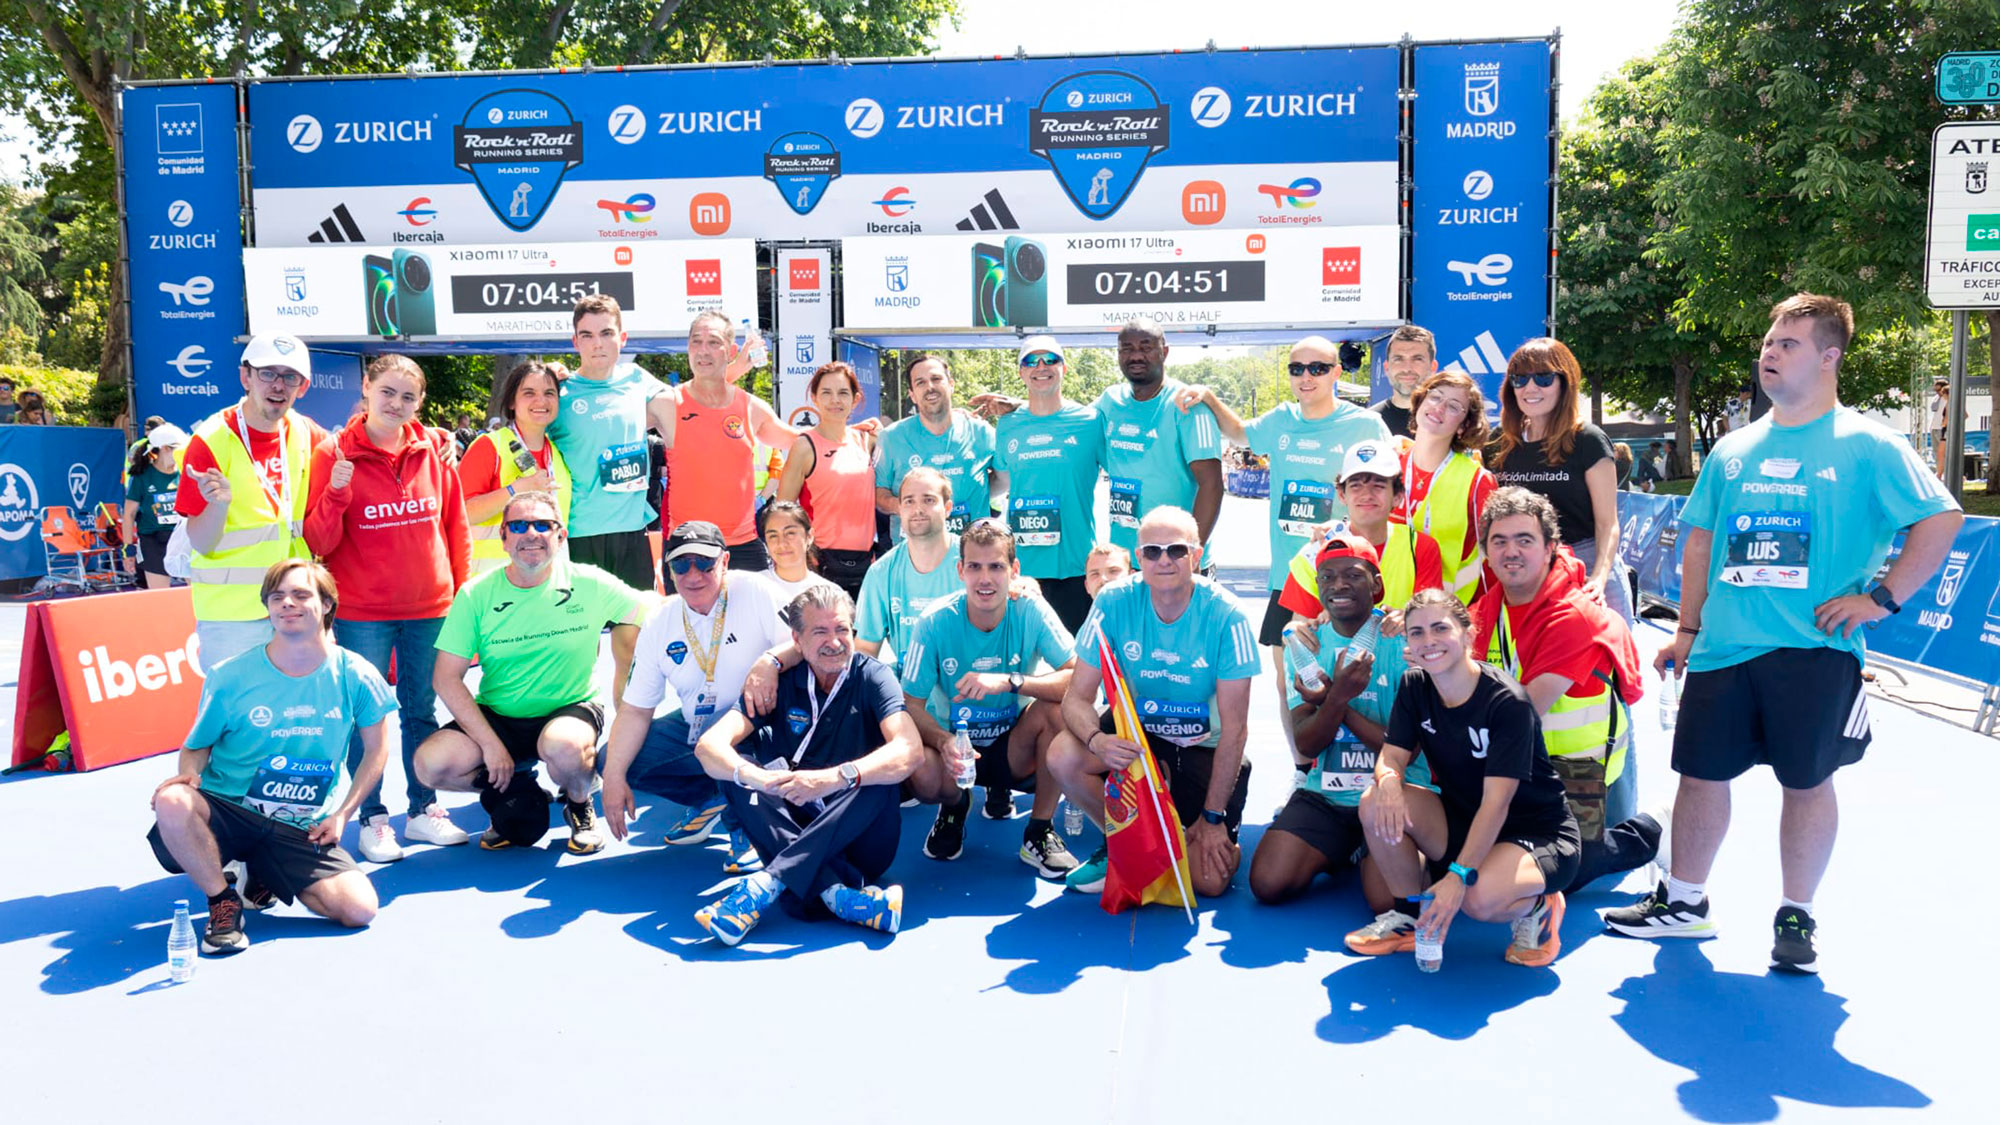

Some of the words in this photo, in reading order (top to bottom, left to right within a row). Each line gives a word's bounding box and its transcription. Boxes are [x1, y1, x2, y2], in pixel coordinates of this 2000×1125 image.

[1088, 92, 1131, 103] ZURICH
[1244, 93, 1356, 118] ZURICH
[507, 110, 548, 120] ZURICH
[897, 104, 1003, 128] ZURICH
[658, 110, 762, 134] ZURICH
[334, 120, 432, 144] ZURICH
[1447, 121, 1516, 139] MADRID
[1051, 133, 1103, 142] RUNNING
[1106, 132, 1147, 141] SERIES
[473, 149, 523, 158] RUNNING
[525, 148, 563, 157] SERIES
[1076, 152, 1122, 160] MADRID
[158, 157, 204, 165] Comunidad
[158, 166, 169, 174] de
[172, 166, 204, 174] Madrid
[498, 166, 540, 174] MADRID
[1258, 215, 1322, 225] TotalEnergies
[1438, 207, 1517, 225] ZURICH
[598, 228, 658, 239] TotalEnergies
[867, 221, 922, 234] Ibercaja
[150, 233, 216, 250] ZURICH
[393, 231, 444, 243] Ibercaja
[1130, 238, 1142, 249] 17
[1146, 237, 1174, 248] Ultra
[508, 249, 518, 260] 17
[522, 249, 549, 260] Ultra
[1095, 269, 1228, 295] 07:04:51
[1447, 290, 1512, 302] TotalEnergies
[875, 297, 920, 308] MADRID
[160, 311, 215, 319] TotalEnergies
[277, 306, 319, 317] MADRID
[1177, 311, 1185, 321] &
[1189, 311, 1221, 321] HALF
[486, 320, 551, 331] MARATHON
[555, 321, 562, 330] &
[787, 367, 818, 376] MADRI
[311, 373, 343, 389] URICH
[162, 382, 219, 397] Ibercaja
[612, 463, 640, 480] PABLO
[1300, 485, 1328, 494] ZURICH
[1742, 483, 1808, 496] POWERADE
[364, 496, 437, 519] envera
[1020, 516, 1049, 529] DIEGO
[1755, 516, 1801, 527] ZURICH
[1747, 541, 1780, 560] LUIS
[1918, 609, 1952, 632] MADRID
[976, 709, 1010, 718] ZURICH
[1163, 705, 1200, 714] ZURICH
[967, 725, 1010, 738] ERMÁN
[1145, 723, 1203, 735] EUGENIO
[290, 762, 328, 772] ZURICH
[262, 781, 318, 801] CARLOS
